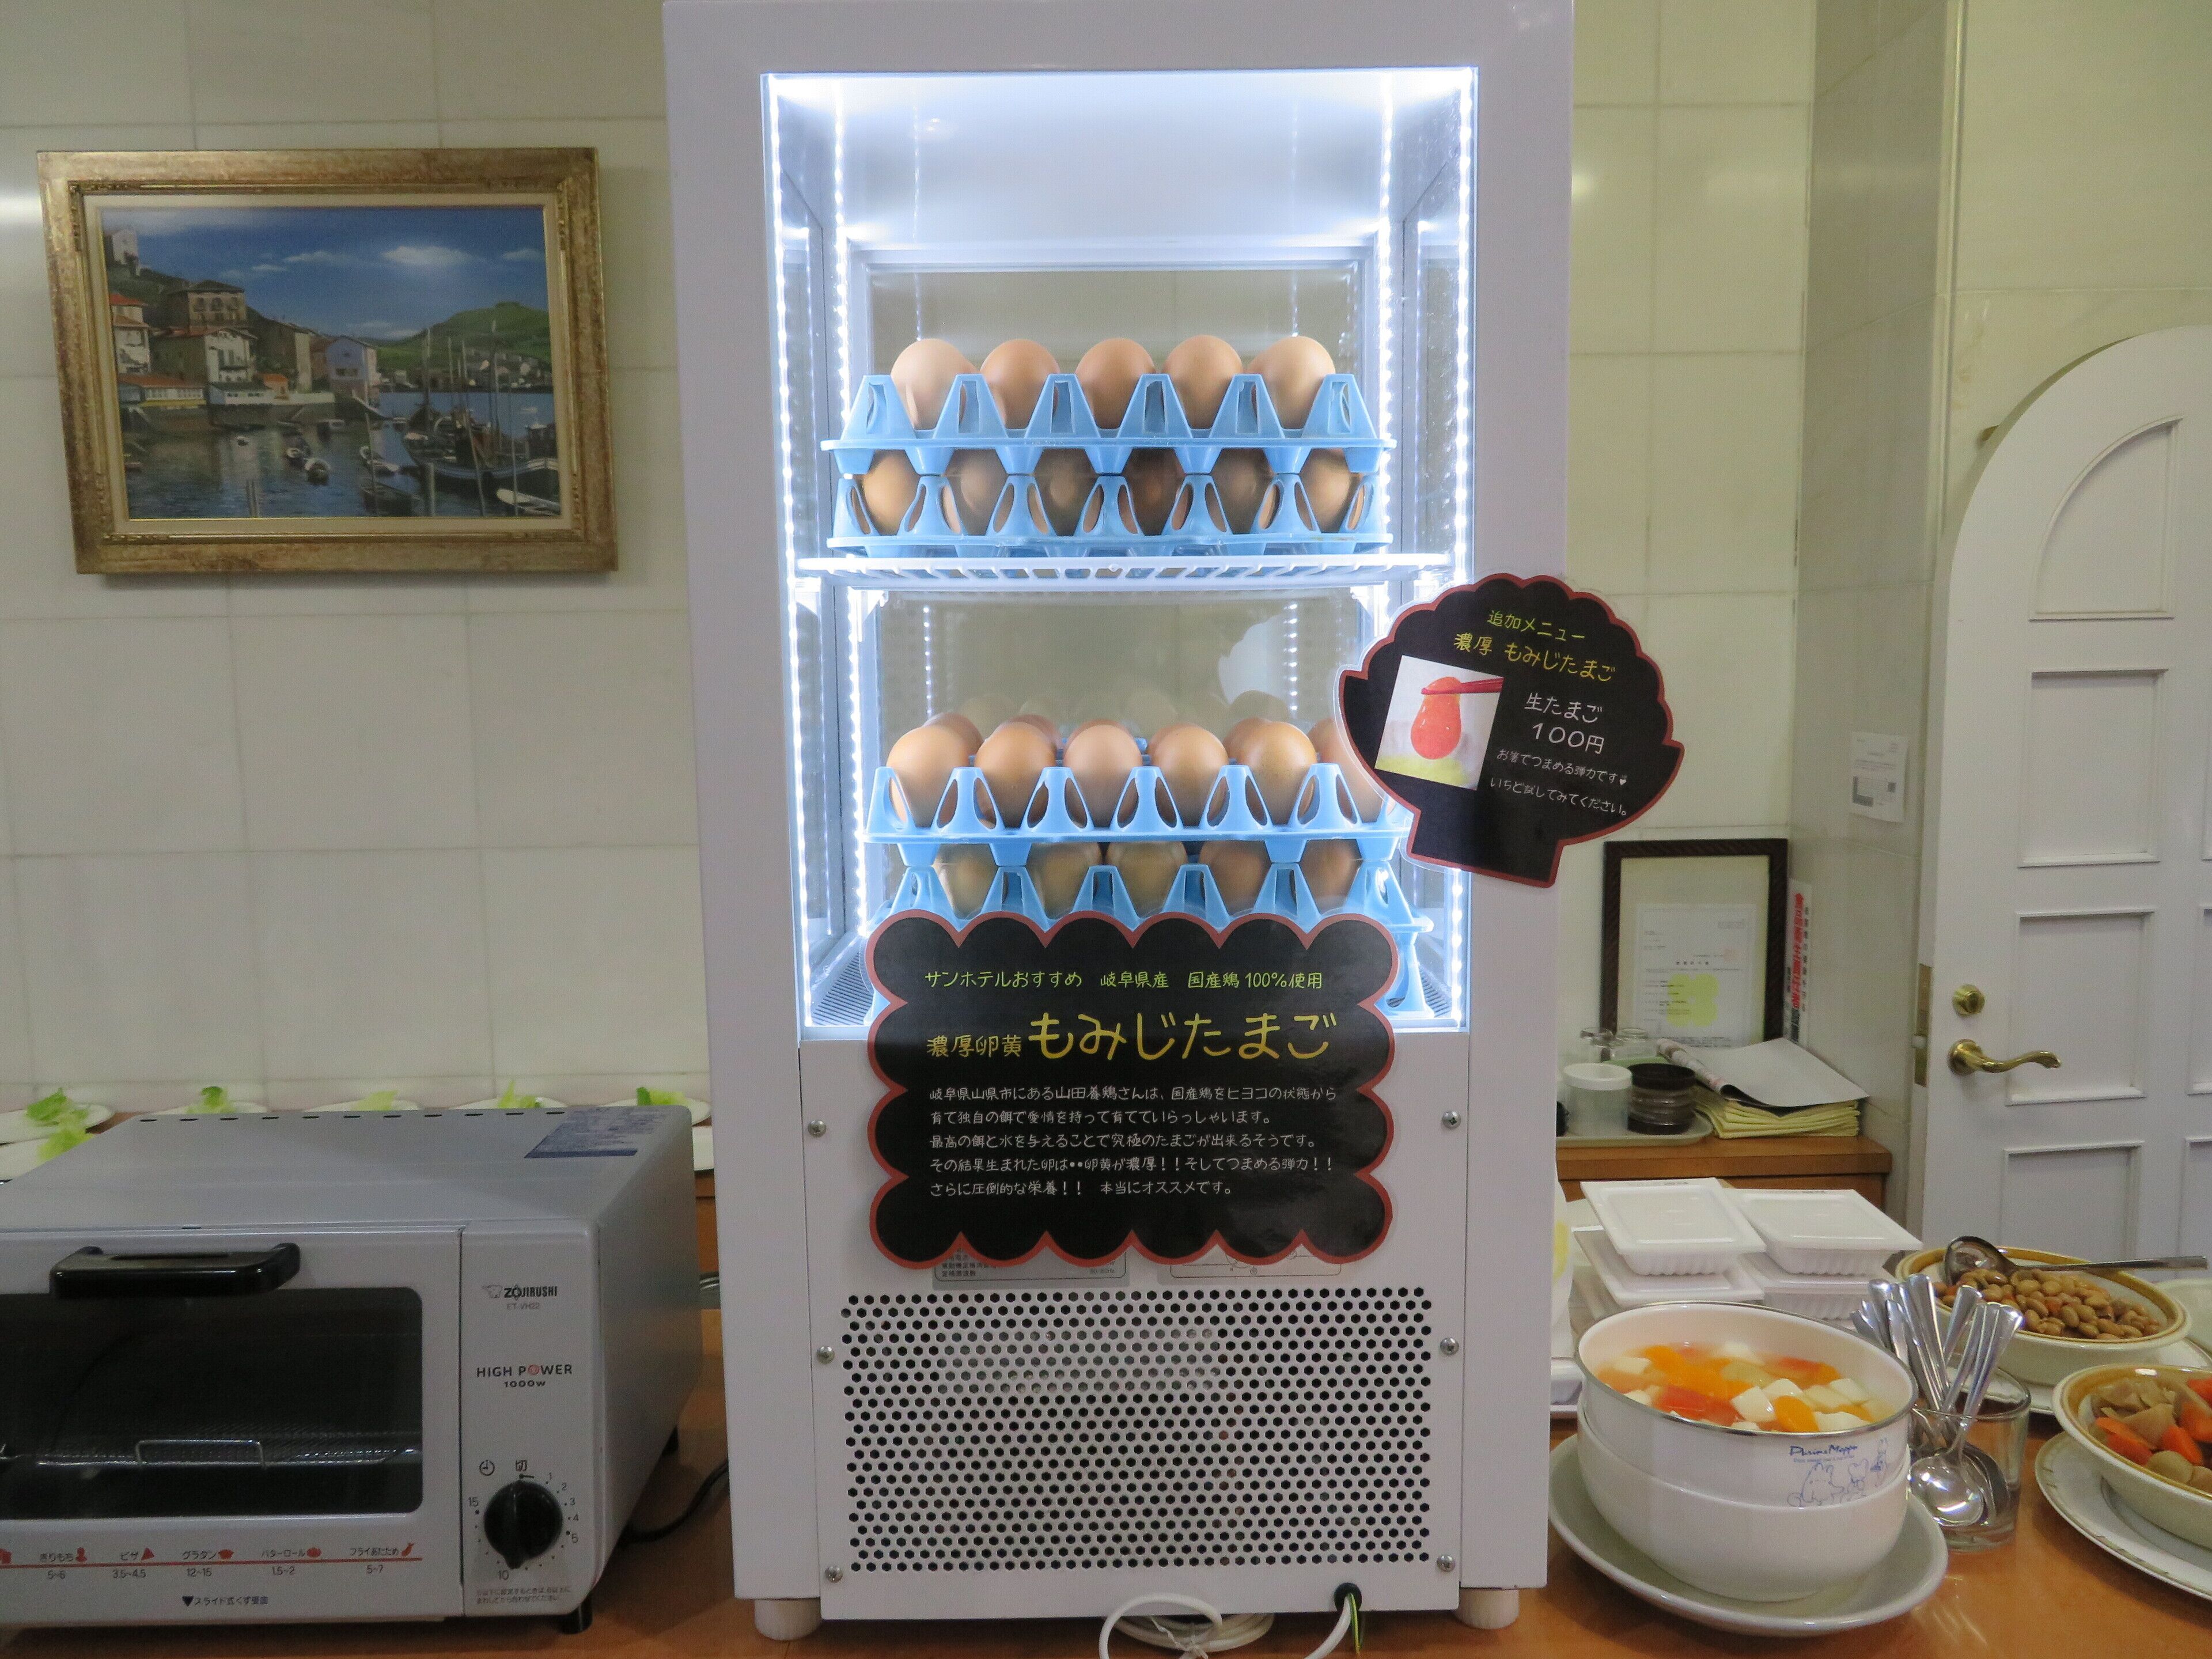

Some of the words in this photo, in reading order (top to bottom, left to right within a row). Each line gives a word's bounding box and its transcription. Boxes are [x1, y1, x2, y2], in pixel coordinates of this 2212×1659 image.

[1486, 609, 1585, 641] 追加メニュー
[1453, 632, 1493, 656] 濃厚
[1504, 642, 1615, 681] もみじたまご
[1524, 692, 1603, 723] 生たまご
[1532, 723, 1604, 754] 100円
[1490, 778, 1627, 816] いちど試してみてください。
[925, 971, 1082, 988] サンホテルおすすめ
[1100, 971, 1169, 988] 岐阜県産
[927, 1035, 1021, 1057] 濃厚卵黄
[1028, 1012, 1337, 1060] もみじたまご
[1100, 1181, 1231, 1196] 本当にオススメです。
[503, 1285, 558, 1301] ZOJIRUSHI
[476, 1366, 513, 1378] HIGH
[518, 1363, 573, 1377] POWER
[515, 1460, 528, 1472] 切
[548, 1472, 552, 1481] 1
[561, 1482, 568, 1491] 2
[468, 1497, 479, 1508] 15
[570, 1497, 576, 1506] 3
[573, 1513, 579, 1522] 4
[571, 1533, 579, 1544] 5
[498, 1570, 509, 1581] 10
